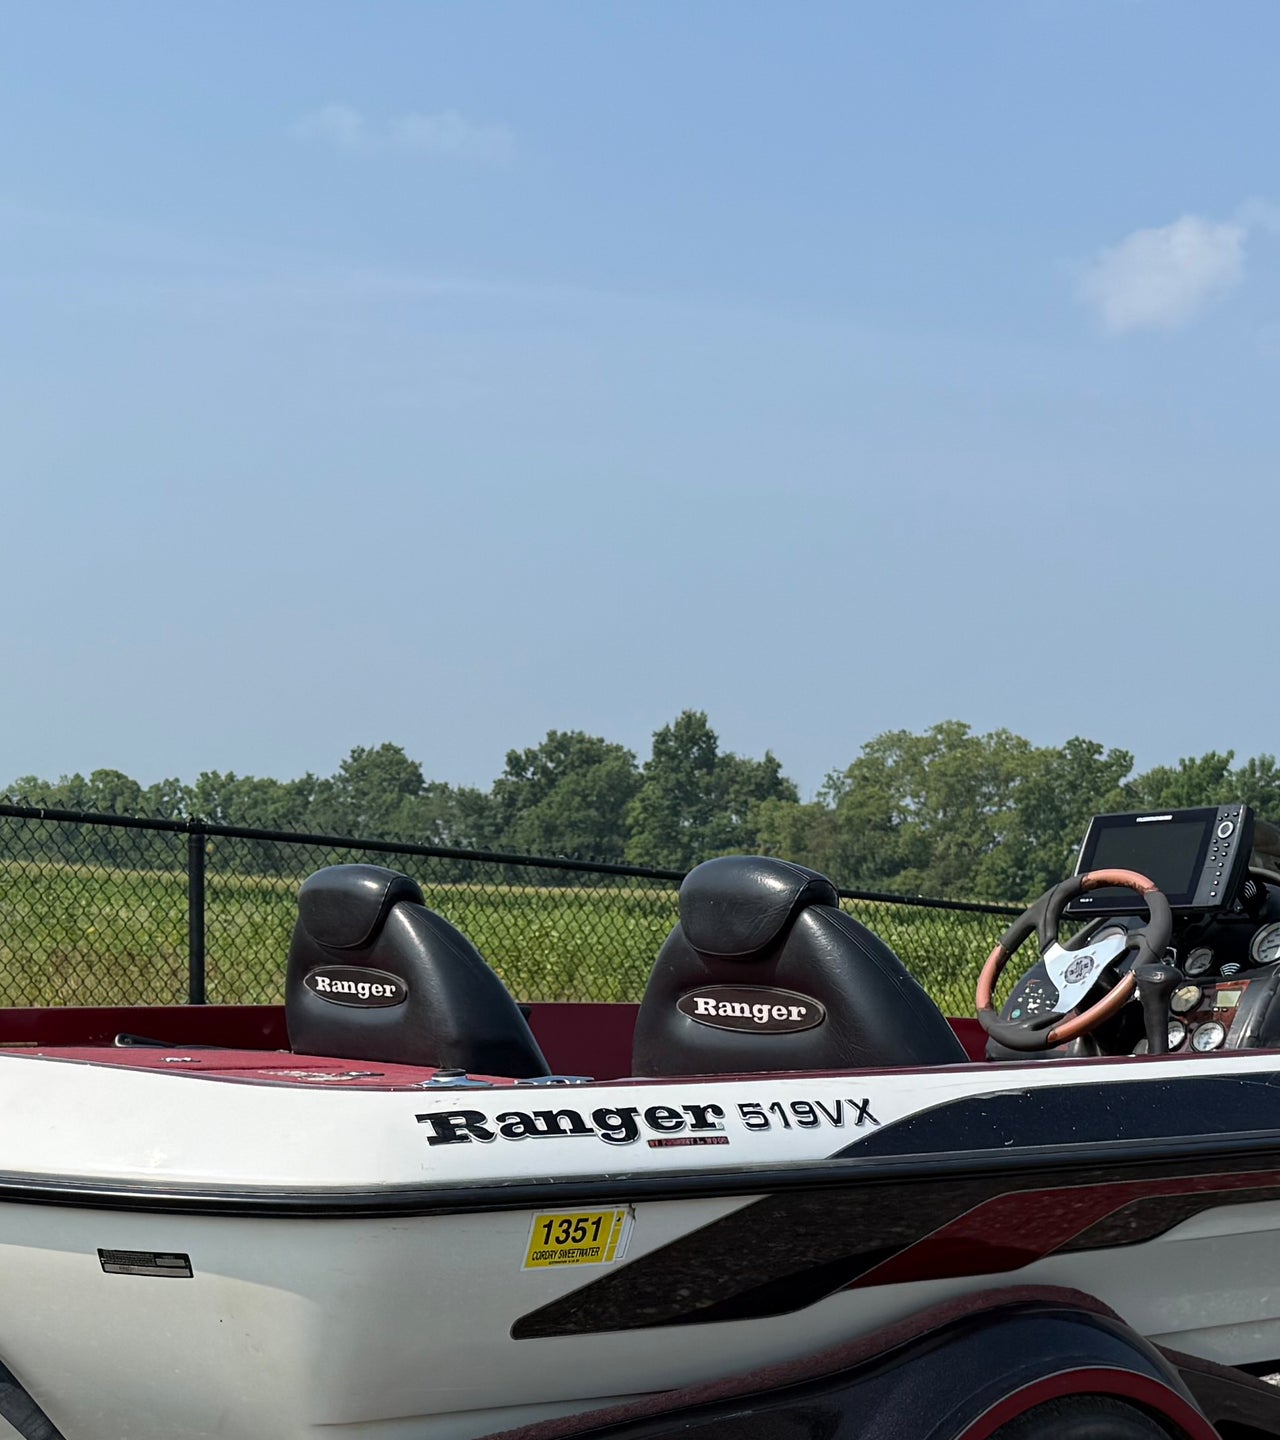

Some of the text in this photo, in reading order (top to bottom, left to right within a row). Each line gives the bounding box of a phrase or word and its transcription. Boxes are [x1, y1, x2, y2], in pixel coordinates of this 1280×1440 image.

[314, 976, 397, 999] Ranger
[693, 997, 807, 1024] Ranger
[414, 1098, 880, 1147] Ranger 519VX
[542, 1216, 603, 1246] 1351
